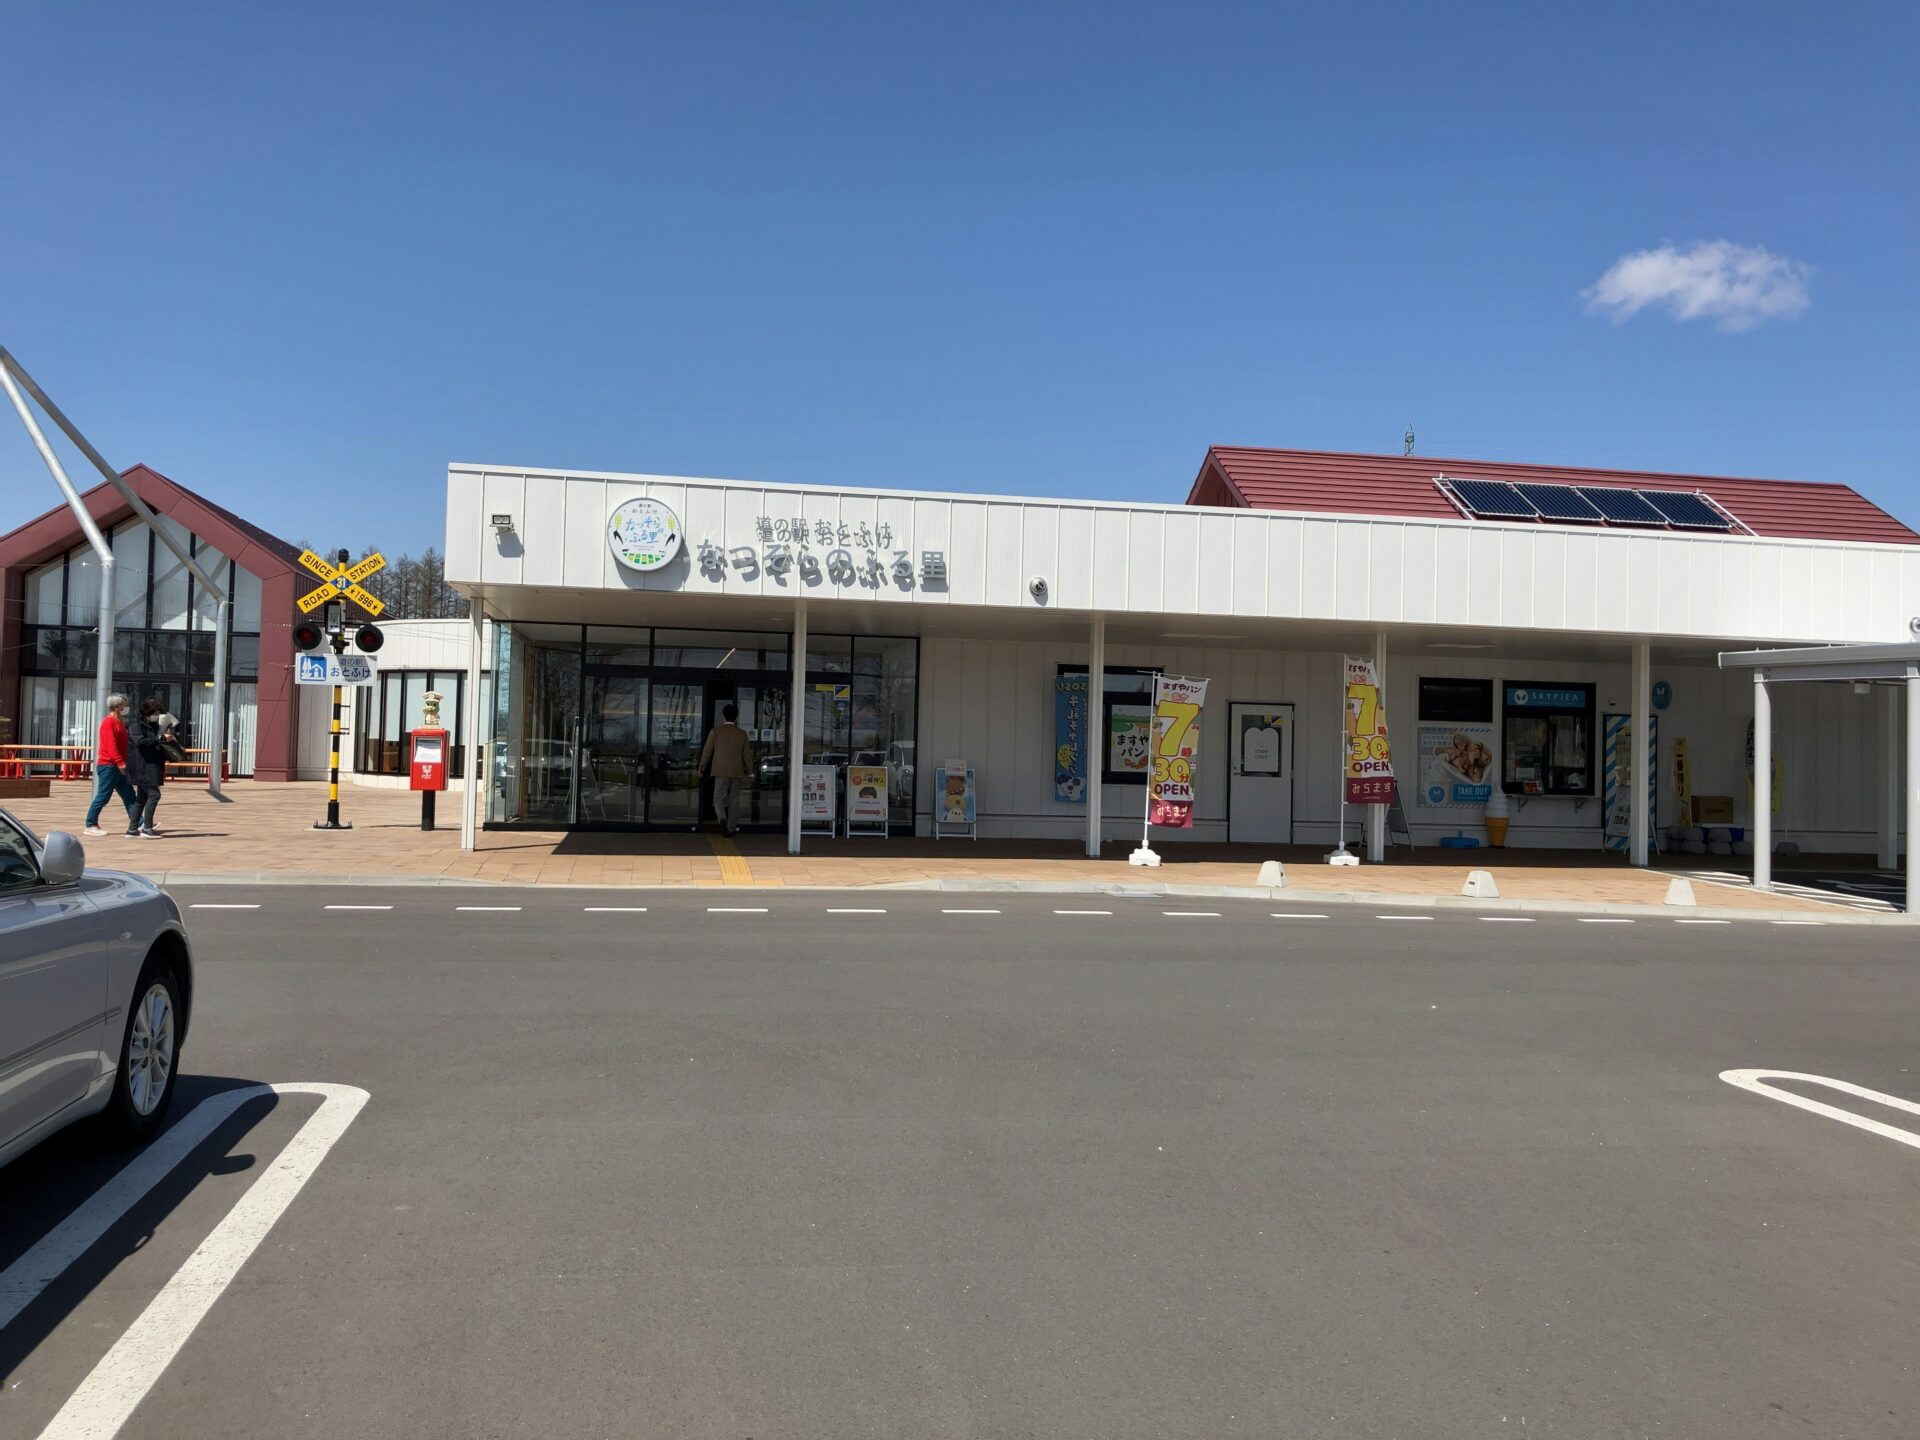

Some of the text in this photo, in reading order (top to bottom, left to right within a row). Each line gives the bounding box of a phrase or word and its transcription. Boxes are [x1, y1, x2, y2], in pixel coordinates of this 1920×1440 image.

[756, 516, 893, 546] 道の駅 おとふけ
[303, 553, 333, 579] SINCE
[349, 557, 381, 580] STATION
[303, 588, 330, 609] ROAD
[355, 590, 374, 608] 1996
[341, 658, 363, 666] 道の駅
[330, 666, 371, 678] おとふけ
[1163, 683, 1201, 693] ますやパン
[1117, 734, 1149, 746] ますや
[1121, 747, 1145, 757] パン
[1352, 761, 1390, 773] OPEN
[1154, 784, 1190, 795] OPEN
[1352, 782, 1391, 794] みちます
[1457, 786, 1488, 796] TAKE OUT
[1156, 805, 1188, 816] みちます
